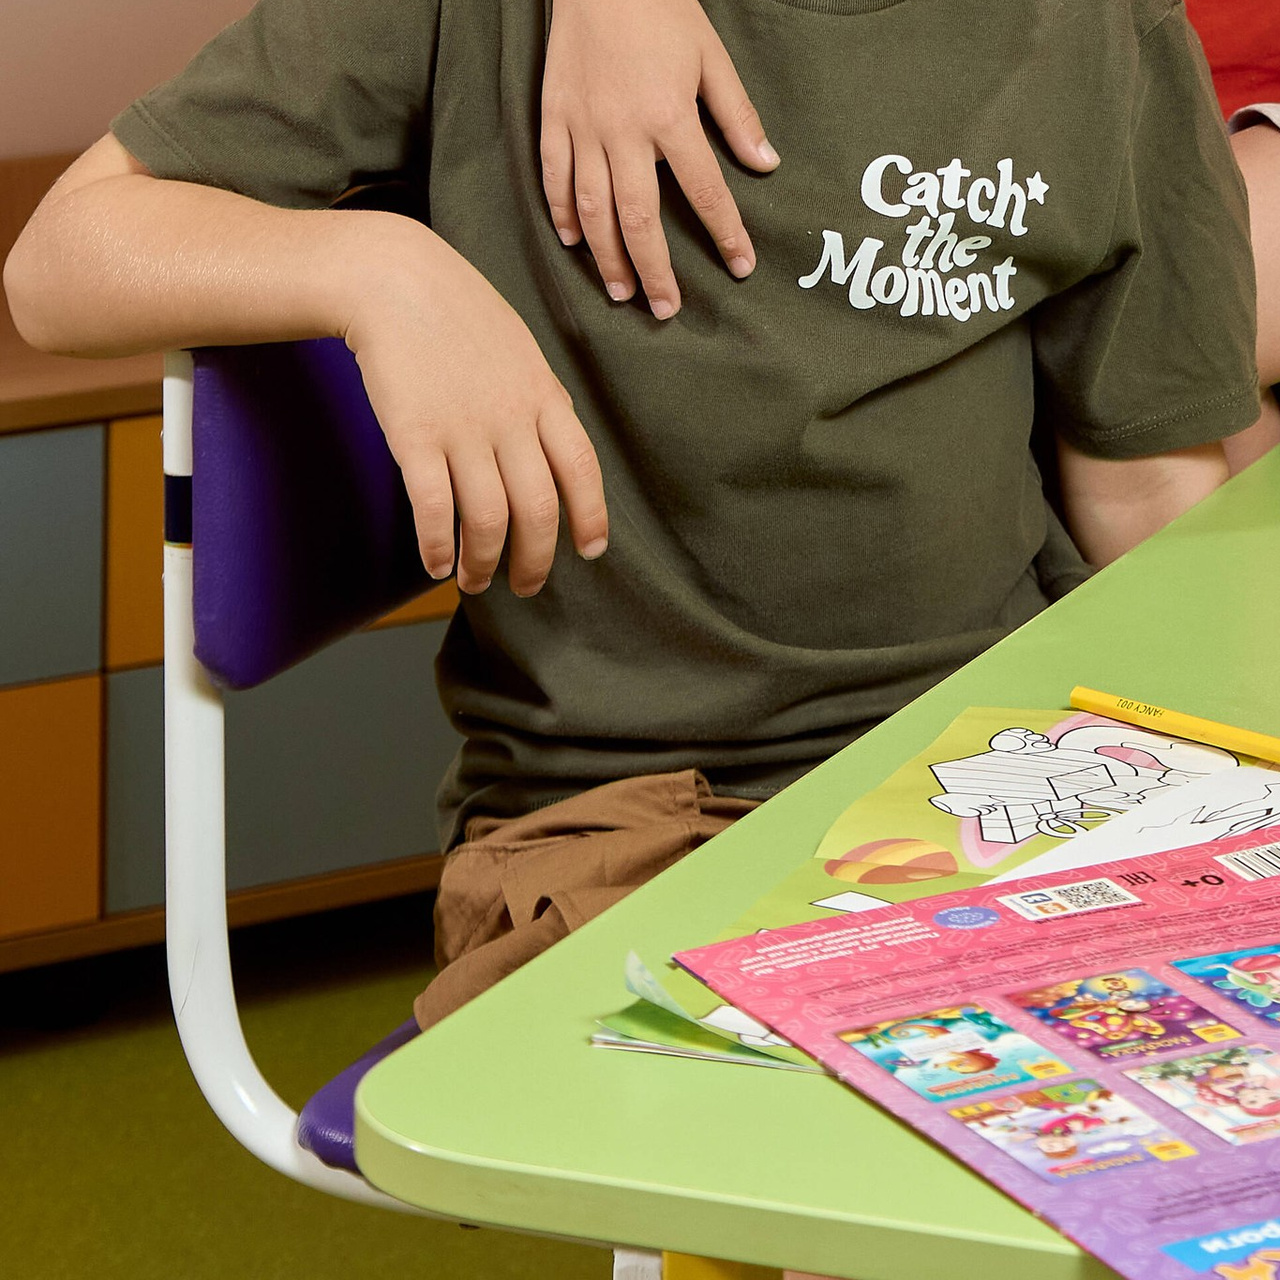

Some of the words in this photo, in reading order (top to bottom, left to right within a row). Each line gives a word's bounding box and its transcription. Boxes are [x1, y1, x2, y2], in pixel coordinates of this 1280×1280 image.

[861, 154, 1028, 237] Catch
[902, 212, 993, 273] the
[798, 230, 1017, 322] Moment
[1116, 699, 1134, 710] 001
[1134, 704, 1164, 717] FANCY
[1177, 873, 1229, 889] 0+
